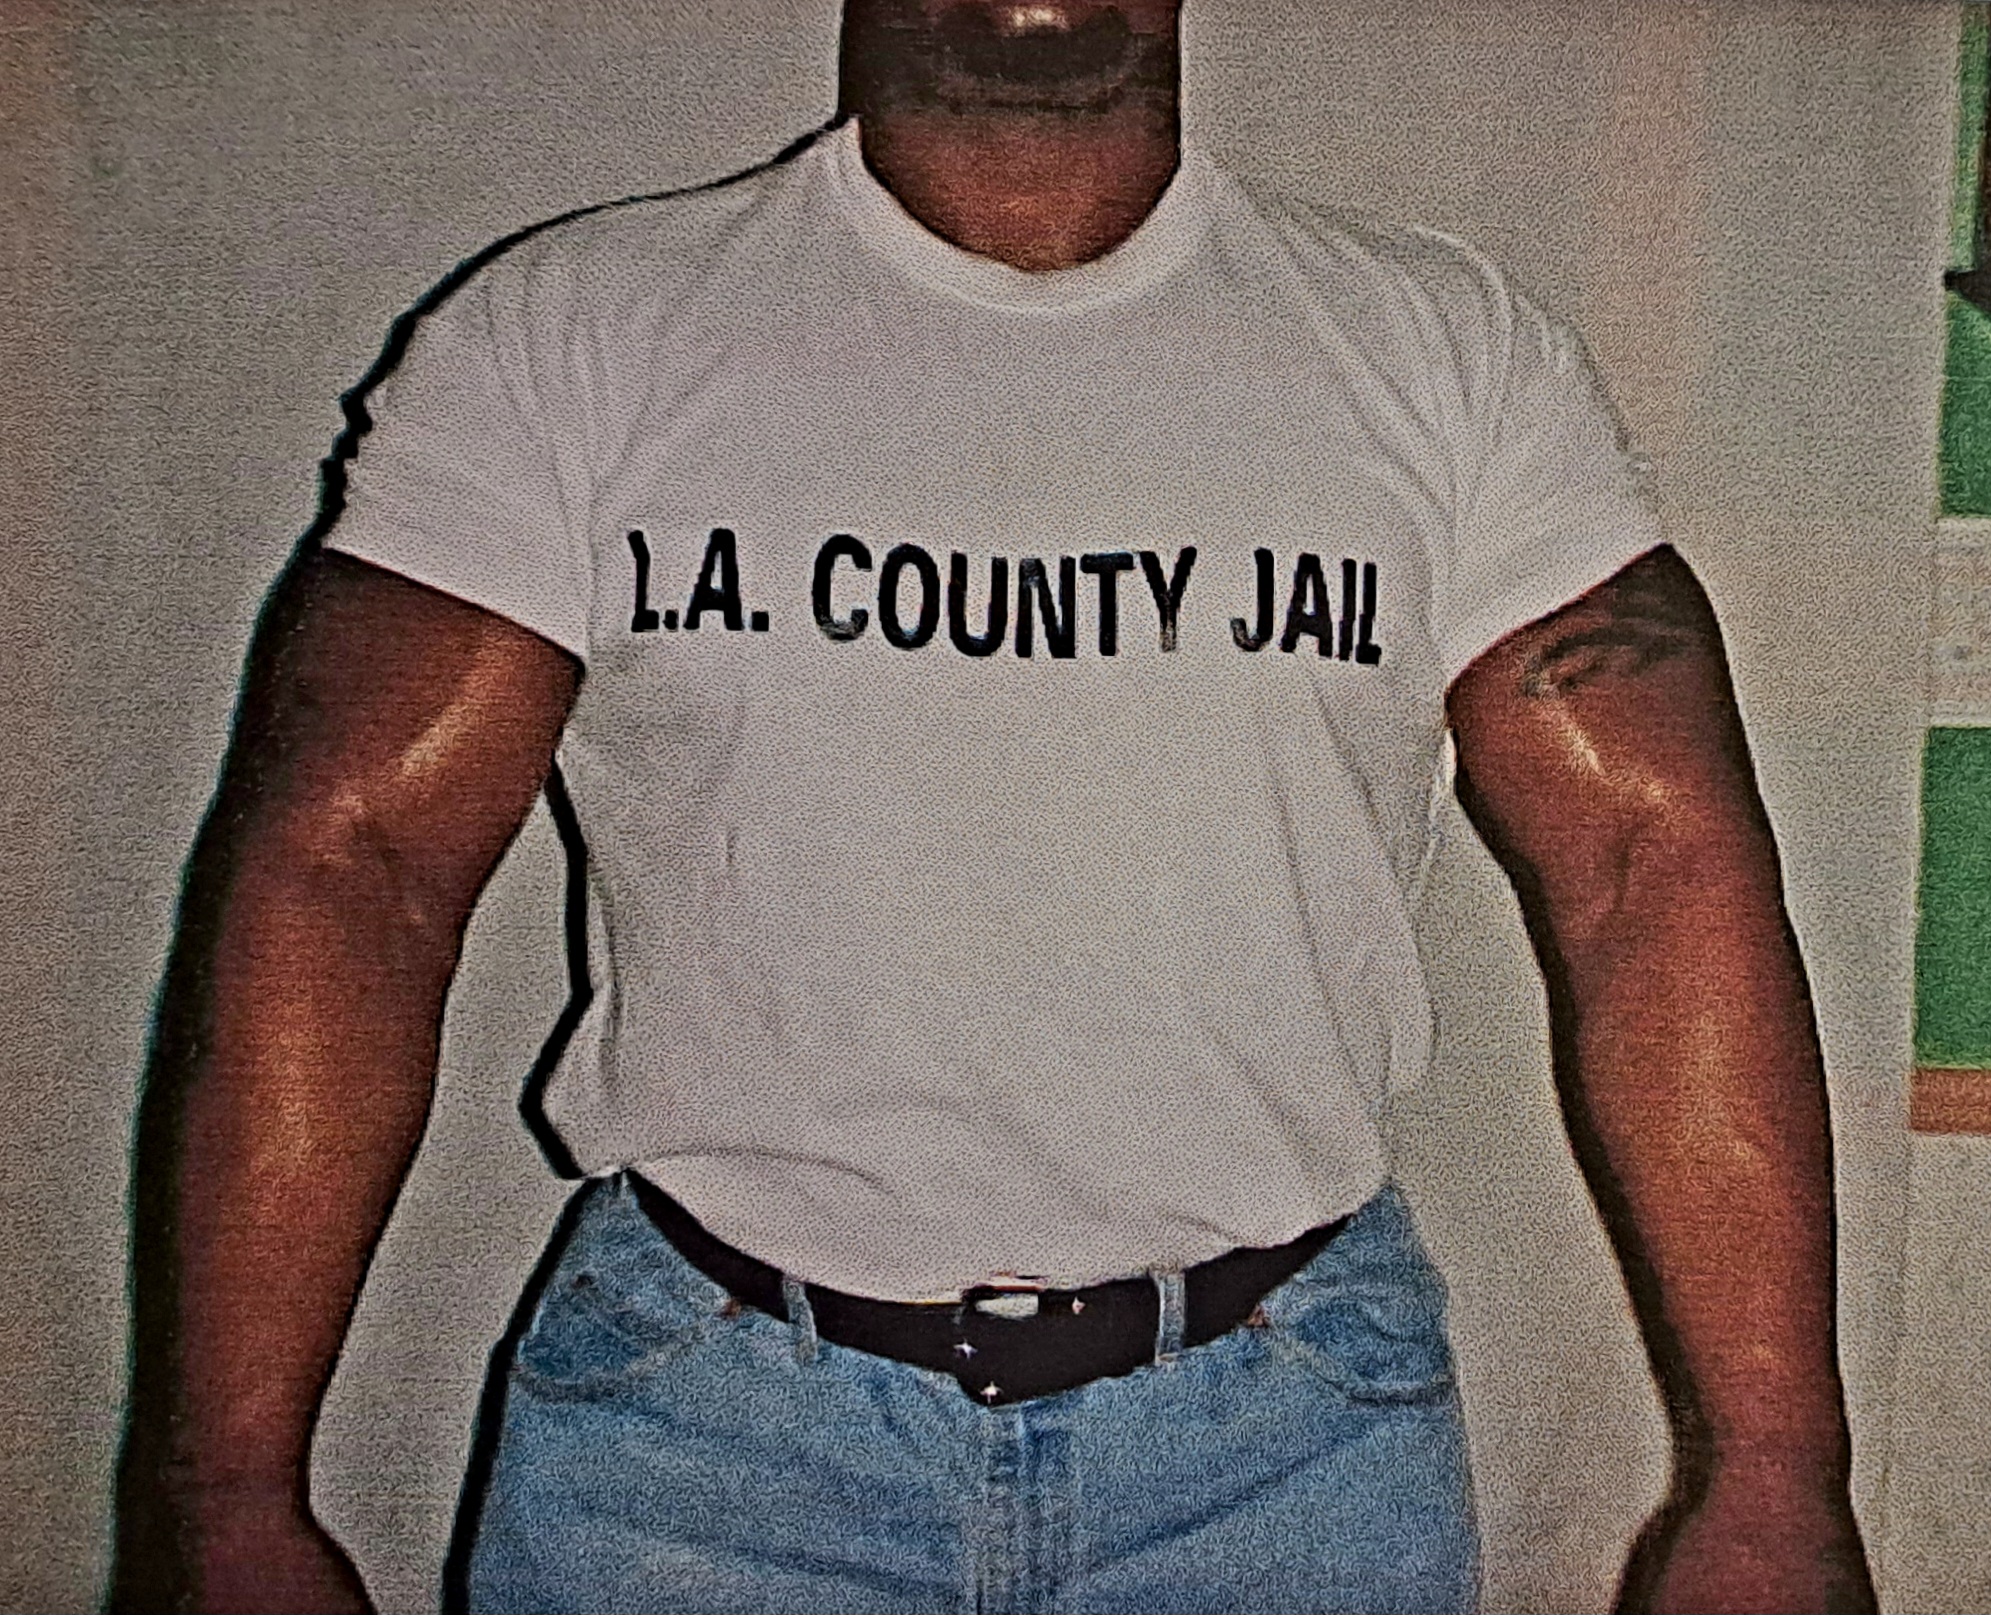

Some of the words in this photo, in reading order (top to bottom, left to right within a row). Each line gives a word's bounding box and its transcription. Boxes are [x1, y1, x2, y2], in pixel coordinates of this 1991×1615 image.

[627, 527, 770, 634] L.A.
[811, 534, 1198, 659] COUNTY
[1230, 547, 1382, 667] JAIL
